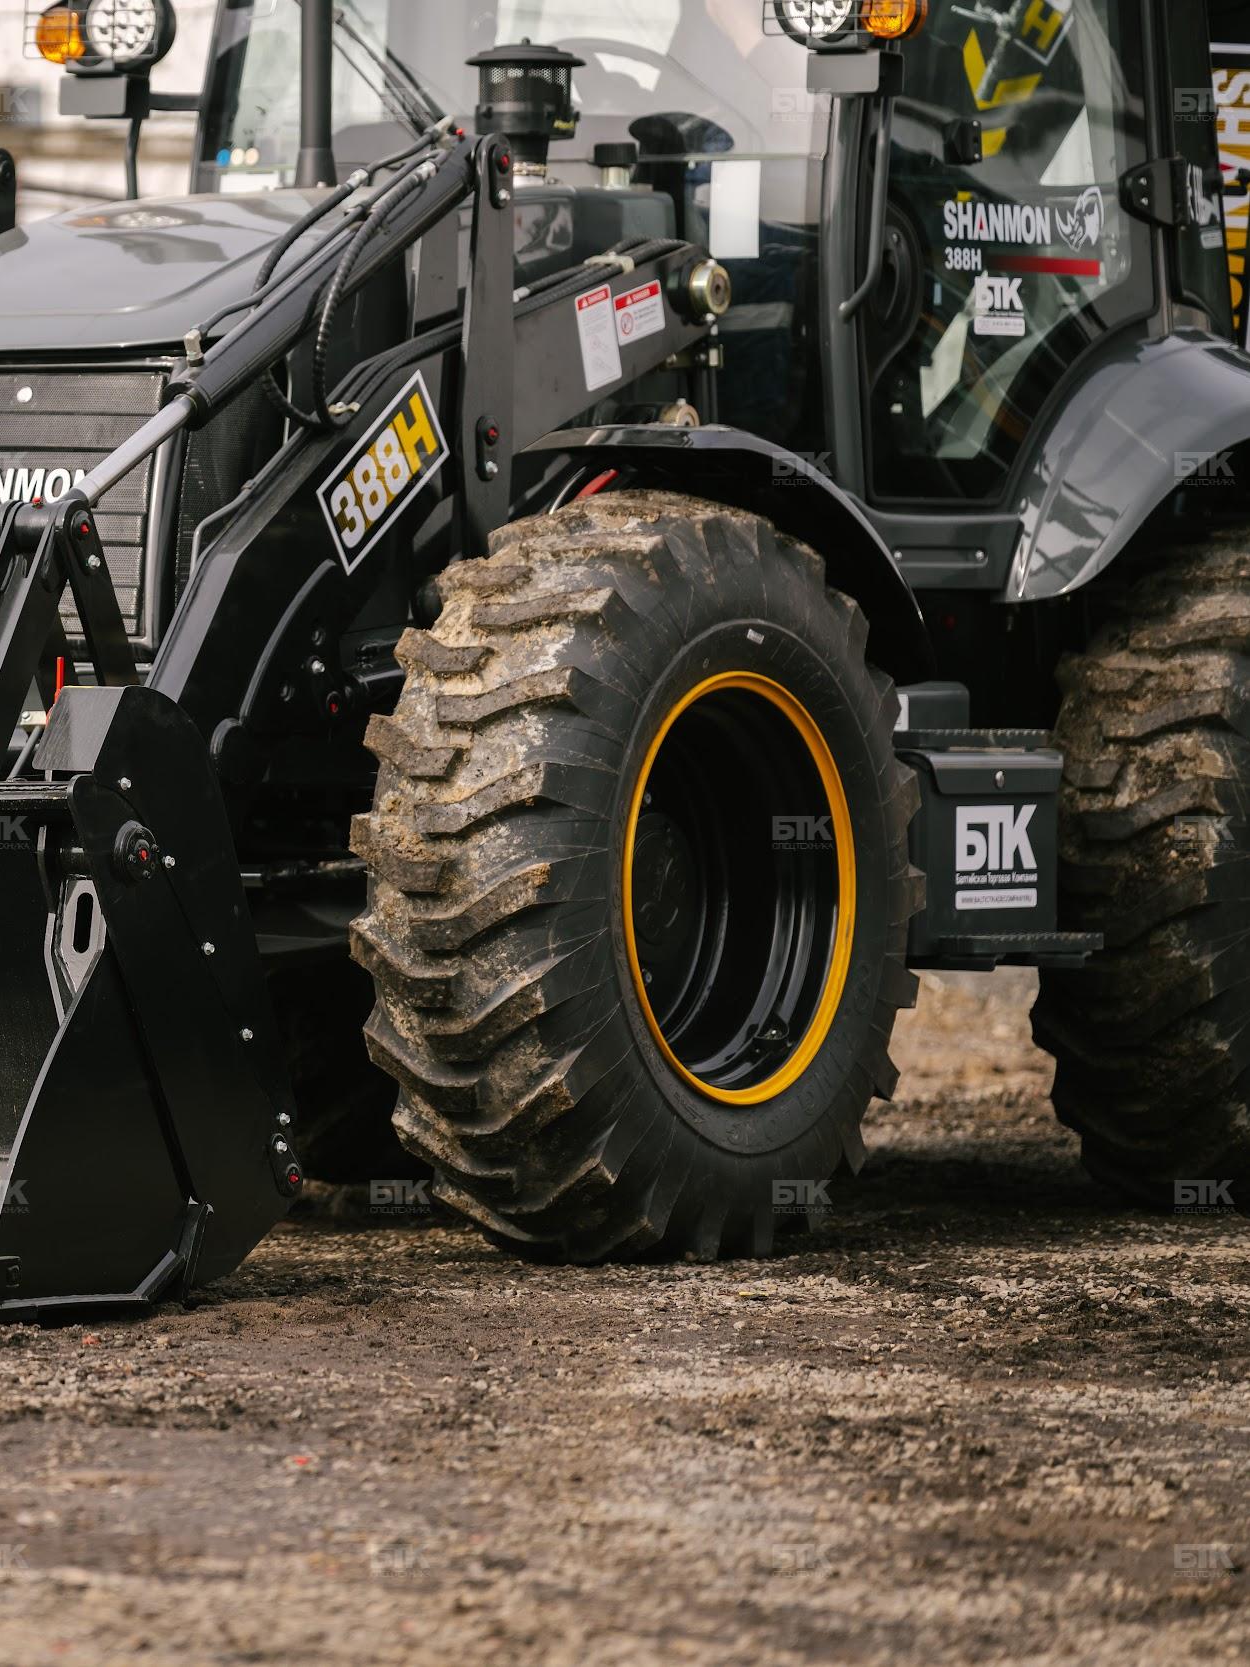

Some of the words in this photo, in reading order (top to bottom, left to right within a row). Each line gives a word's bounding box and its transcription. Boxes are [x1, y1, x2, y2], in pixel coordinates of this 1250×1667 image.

[943, 200, 1051, 245] SHANMON
[944, 246, 982, 271] 388H
[974, 276, 1023, 310] БТК
[330, 391, 438, 549] 388H
[955, 804, 1038, 871] БТК
